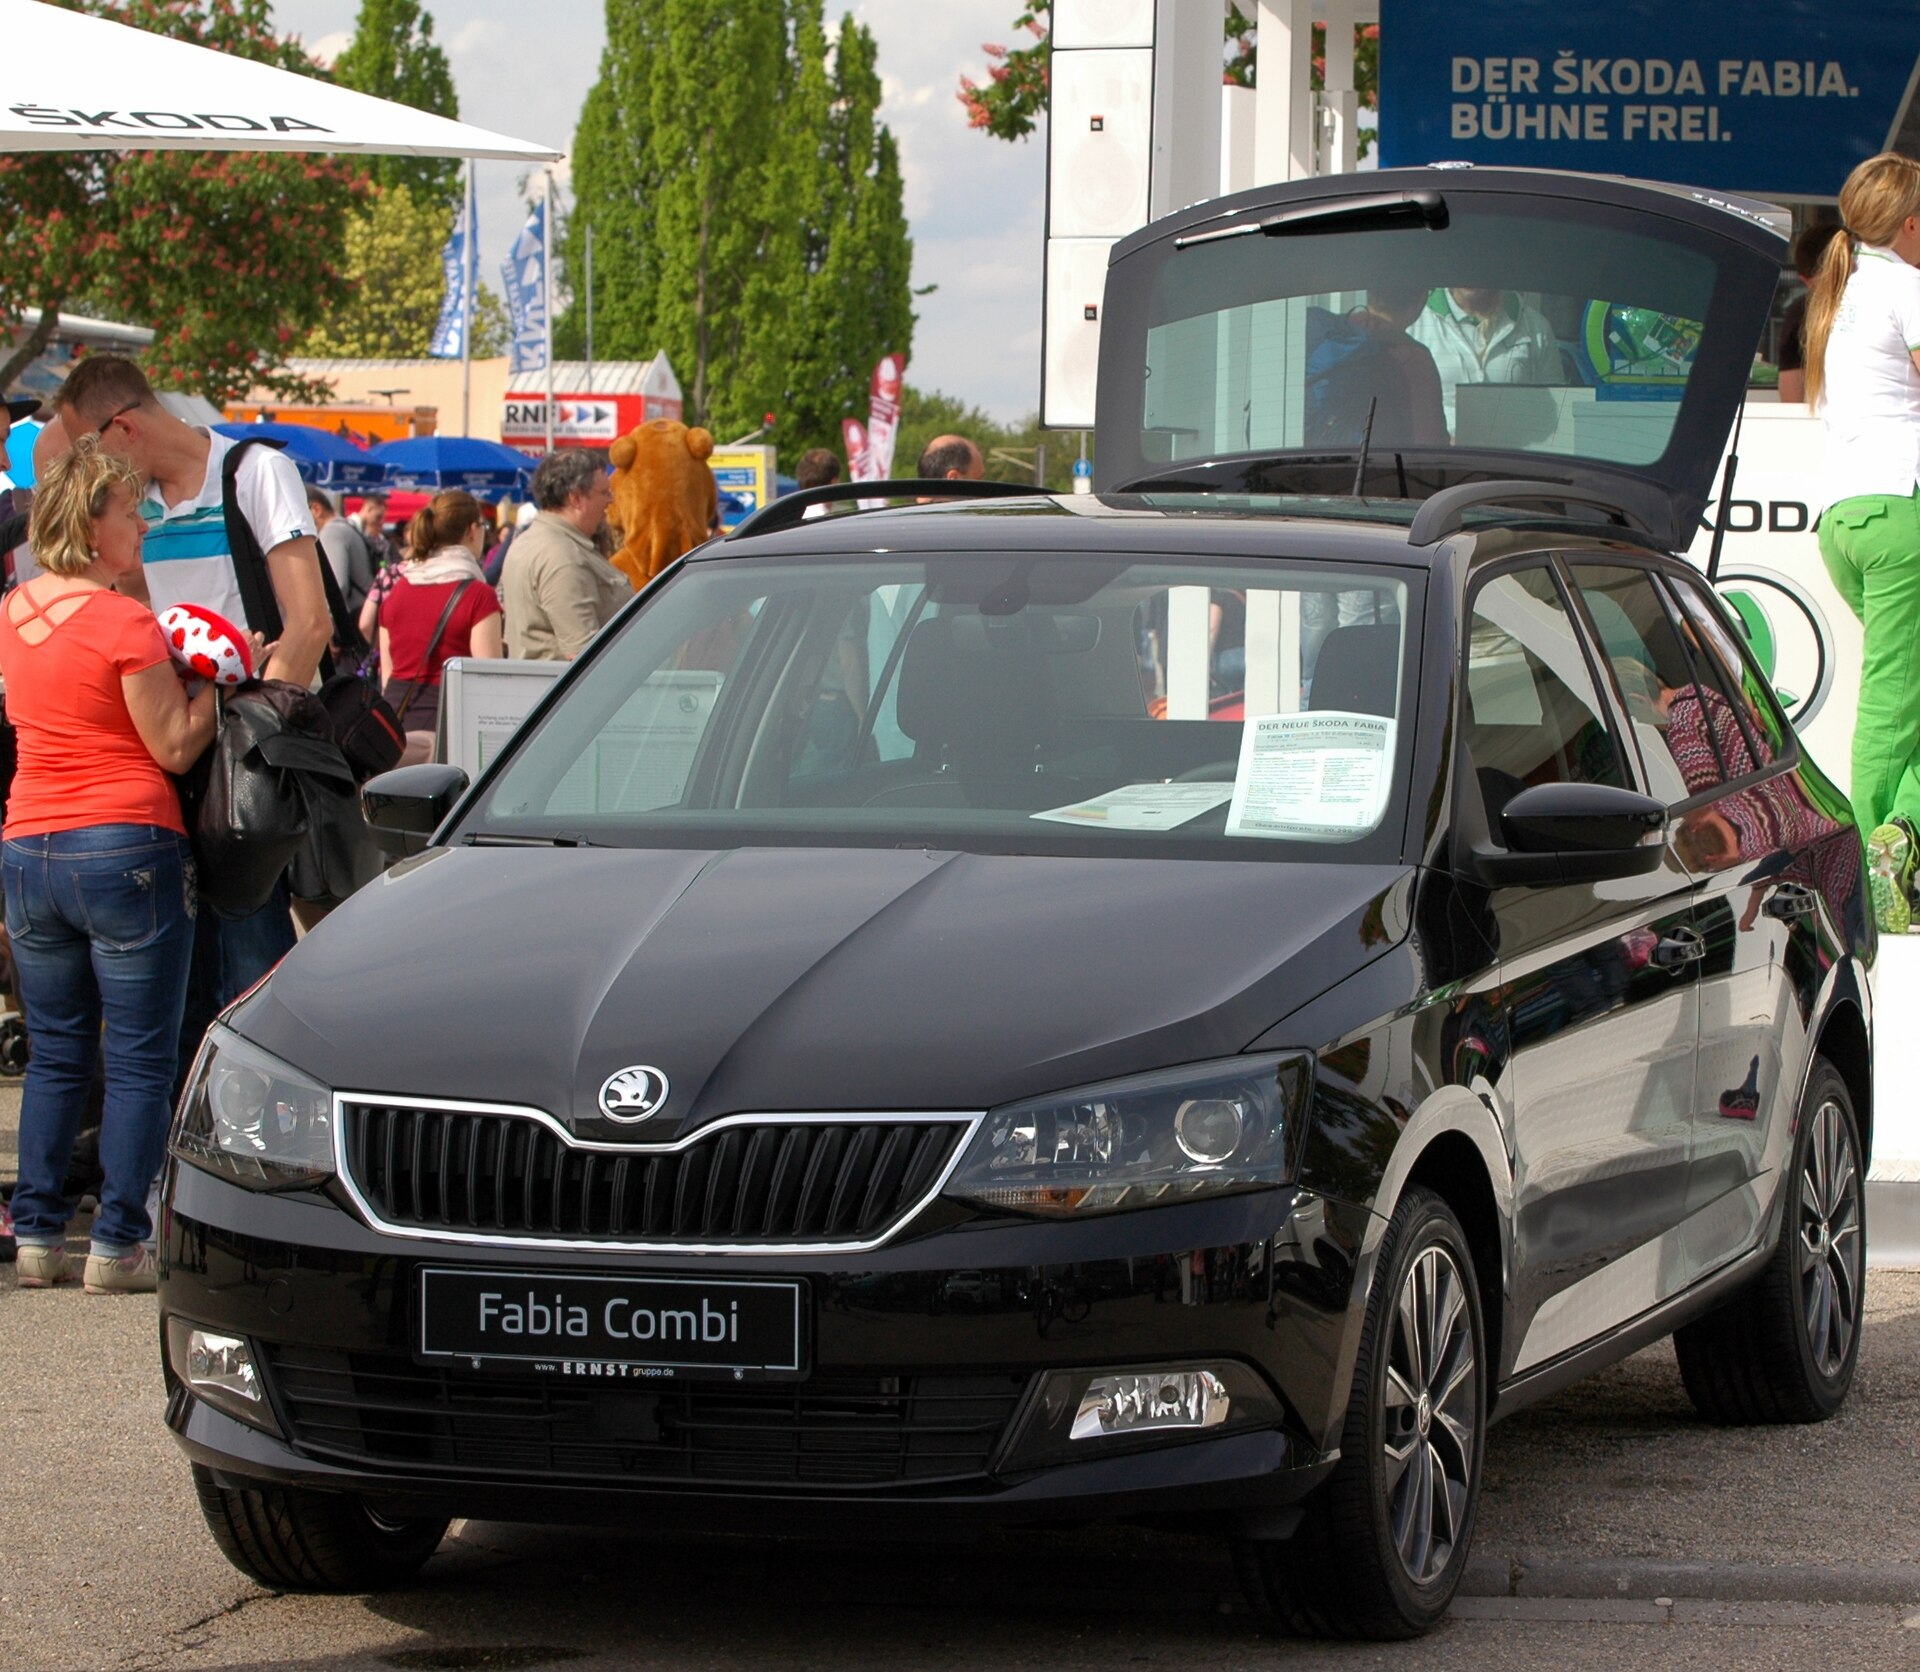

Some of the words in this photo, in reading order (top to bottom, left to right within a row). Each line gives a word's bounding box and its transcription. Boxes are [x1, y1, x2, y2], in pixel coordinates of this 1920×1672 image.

[1452, 57, 1540, 93] DER
[1553, 50, 1705, 95] ŠKODA
[1718, 60, 1859, 97] FABIA.
[9, 102, 336, 133] ŠKODA
[1451, 95, 1608, 139] BÜHNE
[1623, 105, 1732, 141] FREI.
[1258, 723, 1279, 731] DER
[1282, 721, 1309, 729] NEUE
[1312, 719, 1348, 728] ŠKODA
[1354, 721, 1385, 731] FABIA
[479, 1291, 588, 1336] Fabia
[604, 1298, 738, 1342] Combi
[534, 1363, 558, 1372] www.
[563, 1361, 628, 1377] ERNST
[633, 1366, 674, 1377] gruppe.de
